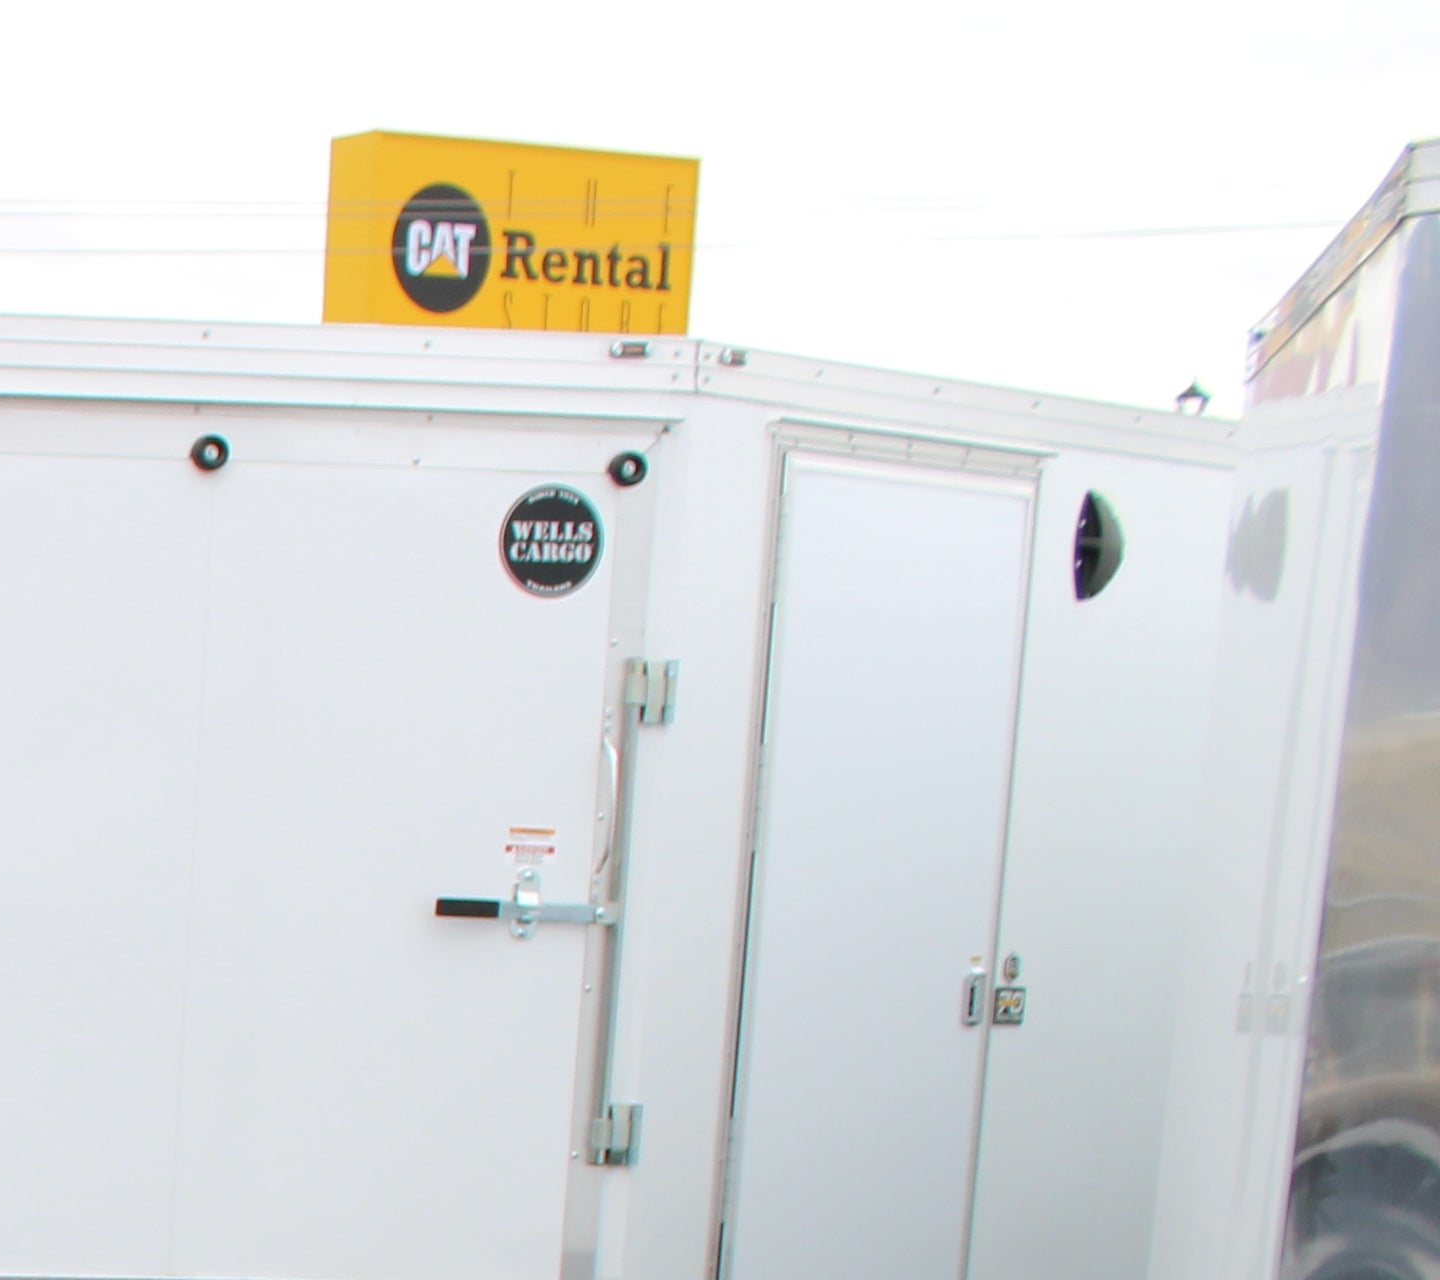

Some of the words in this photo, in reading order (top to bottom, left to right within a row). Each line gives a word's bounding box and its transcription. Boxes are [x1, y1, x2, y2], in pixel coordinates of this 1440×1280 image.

[405, 218, 477, 280] CAT
[500, 229, 672, 292] Rental
[509, 541, 594, 563] CARGO
[511, 520, 594, 543] WELLS
